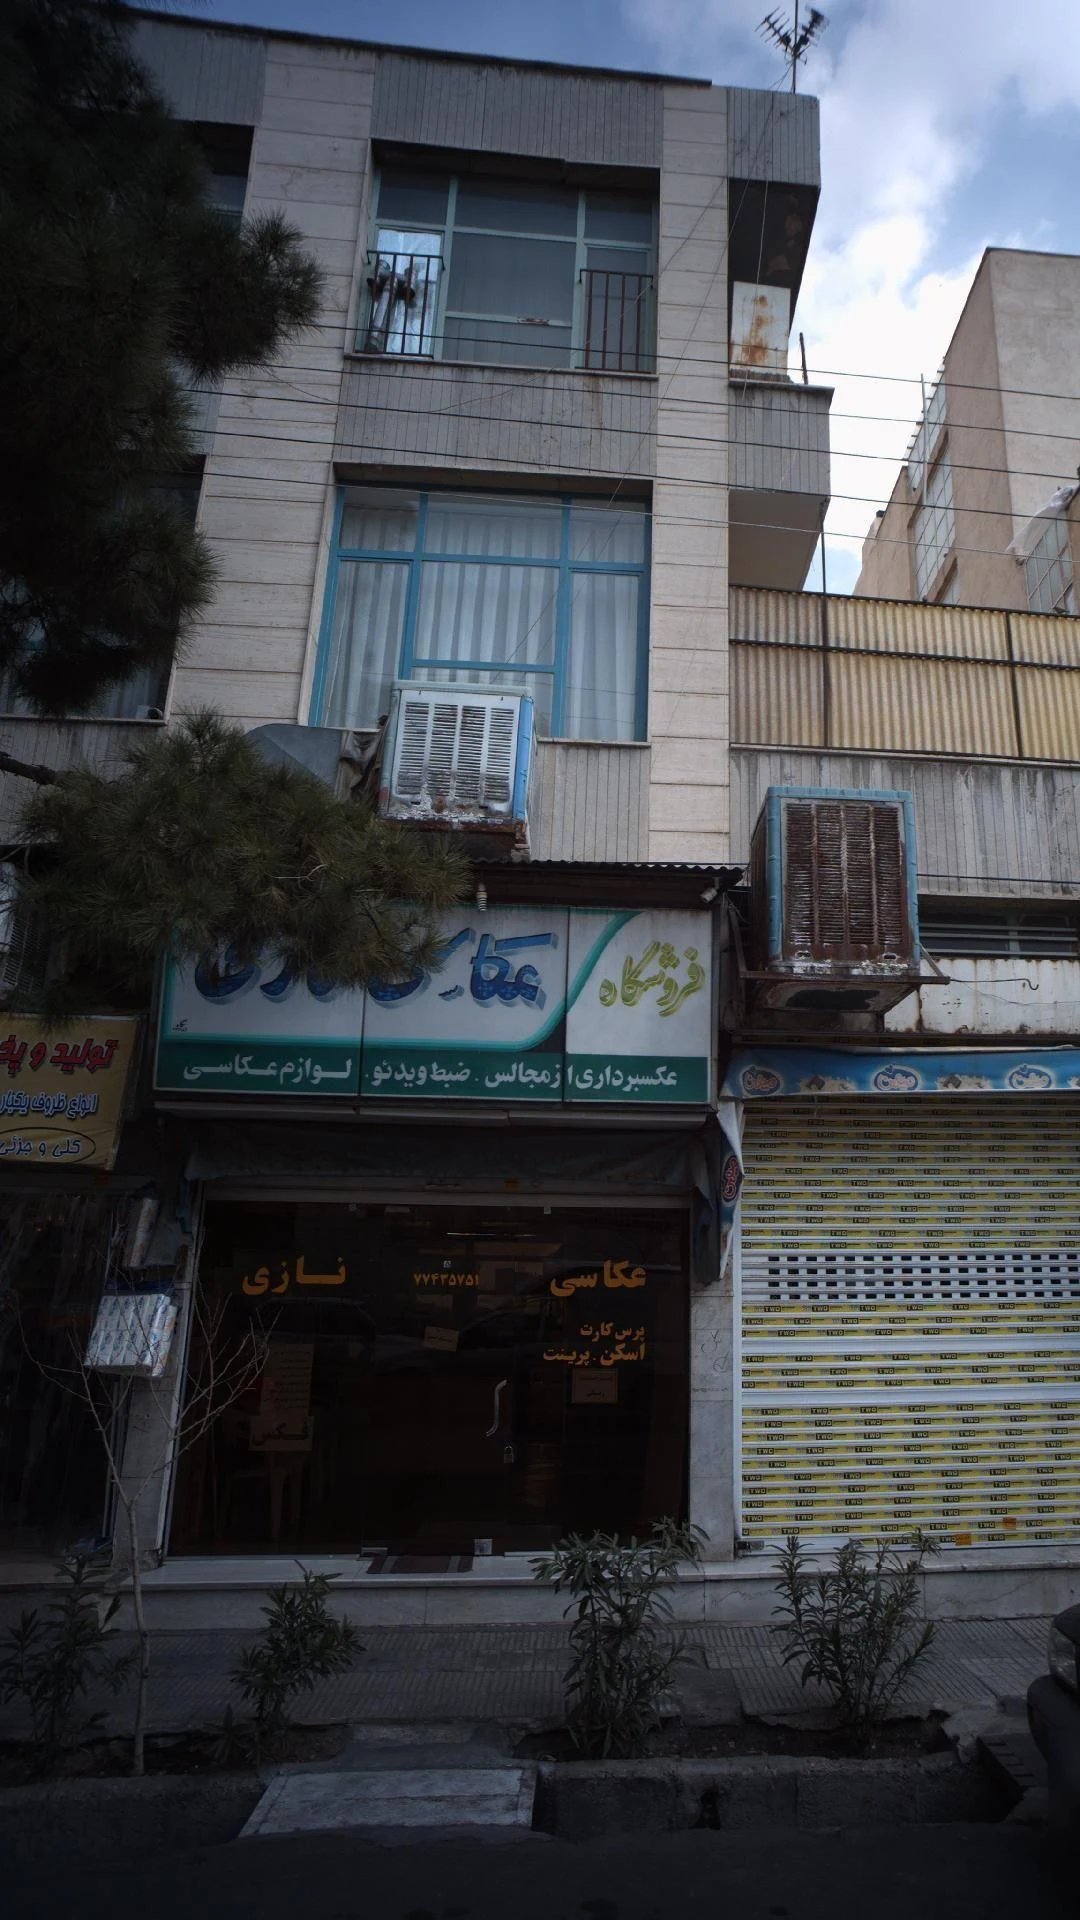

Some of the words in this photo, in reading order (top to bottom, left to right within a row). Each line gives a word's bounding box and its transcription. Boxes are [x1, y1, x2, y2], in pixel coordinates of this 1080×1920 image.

[599, 940, 705, 1017] فروشگاه
[30, 1041, 47, 1071] و
[50, 1038, 119, 1073] تولید
[182, 1053, 278, 1081] عکاسی
[279, 1056, 353, 1085] لوازم
[371, 1059, 427, 1087] ویدئو
[429, 1061, 471, 1088] ضبط
[484, 1061, 551, 1089] مجالس
[575, 1064, 678, 1092] عکسبرداری
[31, 1091, 66, 1117] ظروف
[67, 1093, 98, 1120] انواع
[38, 1141, 47, 1157] و
[52, 1138, 81, 1158] کلی
[241, 1254, 348, 1297] نازی
[549, 1258, 648, 1297] عکاسی
[579, 1320, 614, 1343] کارت
[614, 1325, 646, 1342] پرس
[542, 1347, 591, 1366] پرینت
